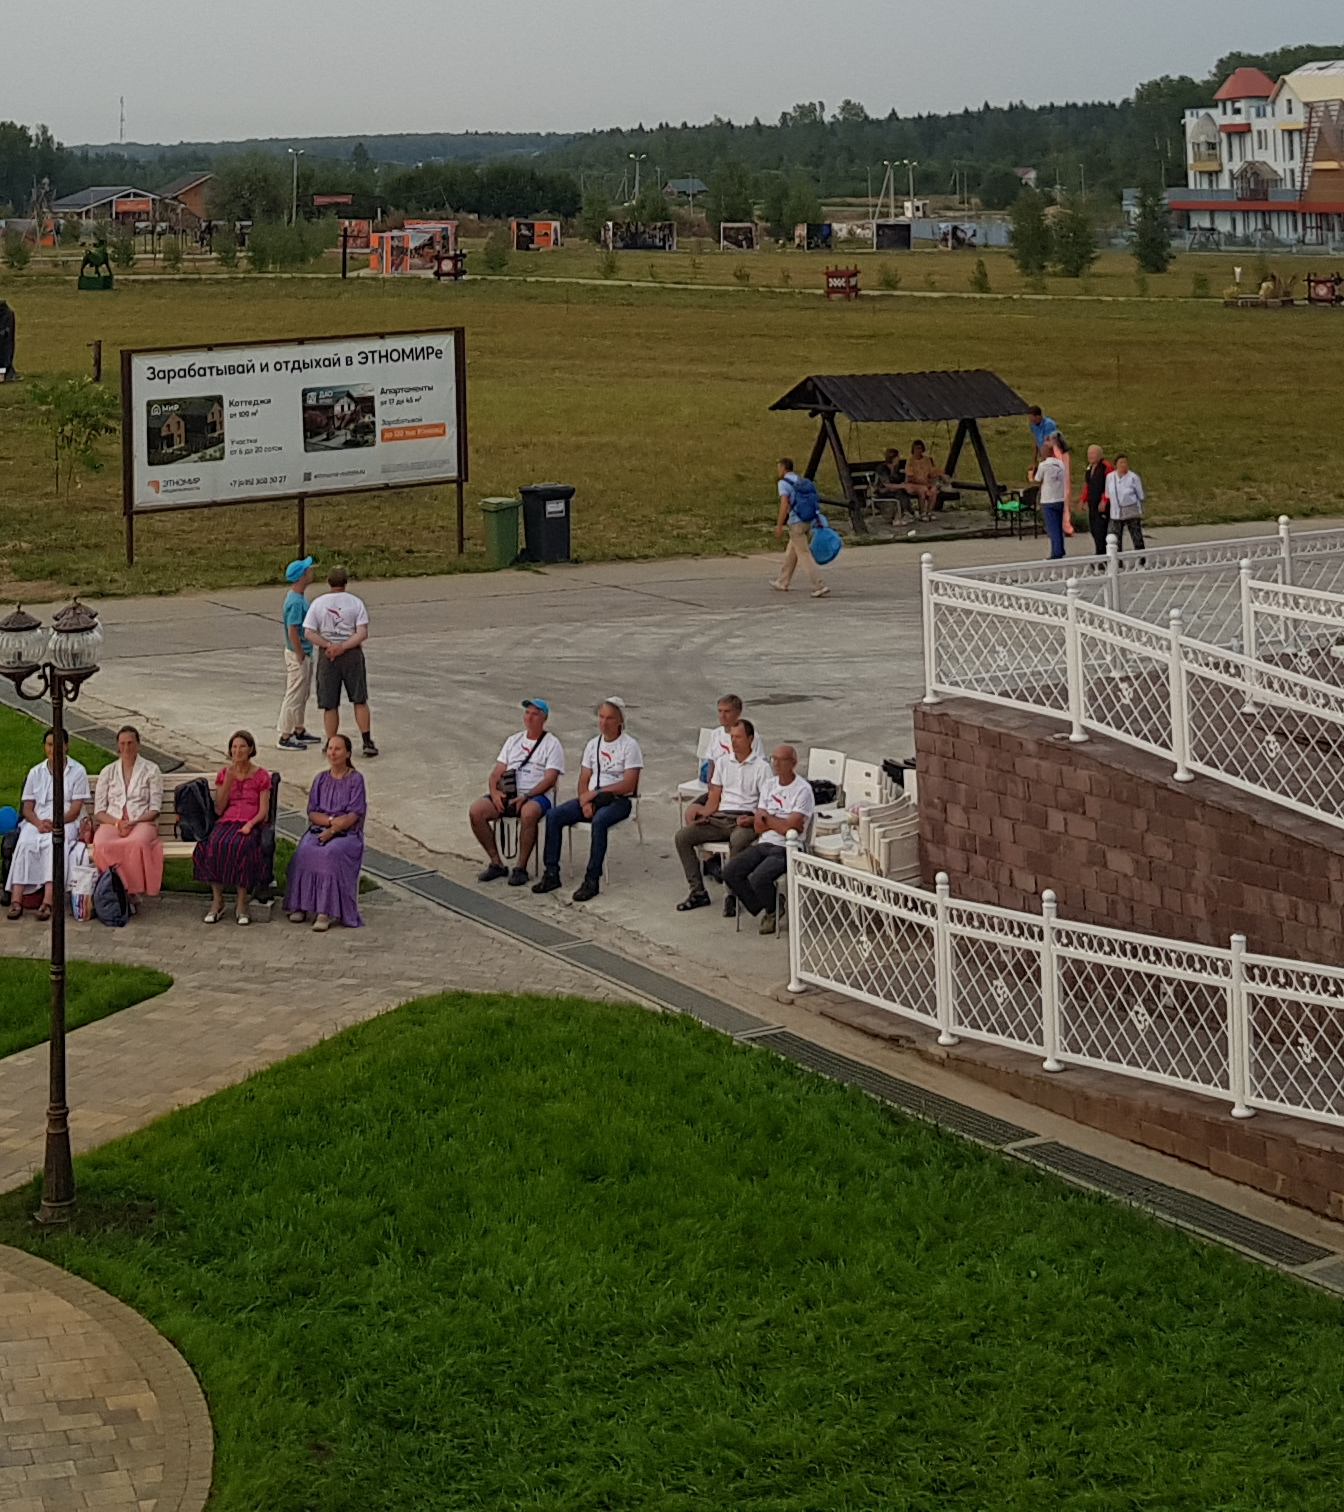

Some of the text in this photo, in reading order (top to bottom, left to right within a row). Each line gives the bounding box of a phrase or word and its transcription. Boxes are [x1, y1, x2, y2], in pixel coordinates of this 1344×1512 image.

[146, 345, 444, 385] Зарабатывай и отдыхай в ЭТНОМИРе
